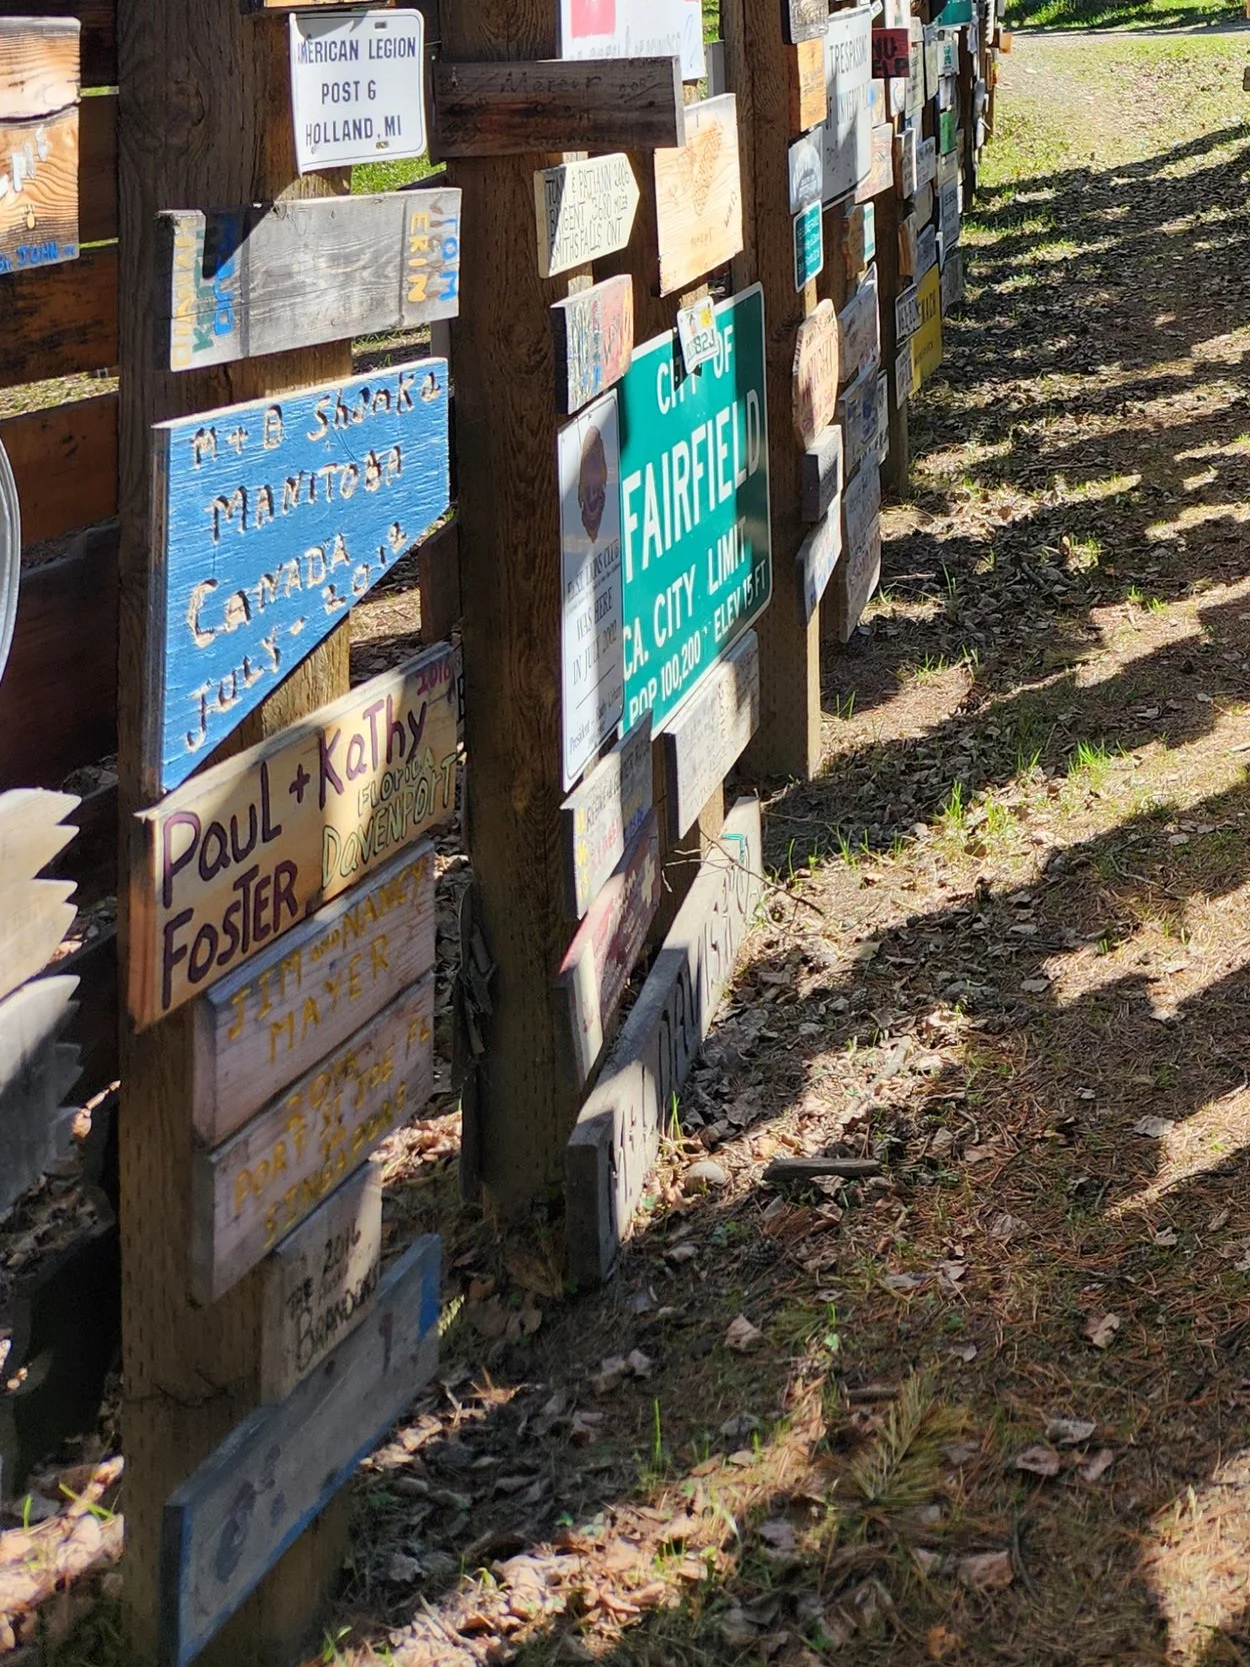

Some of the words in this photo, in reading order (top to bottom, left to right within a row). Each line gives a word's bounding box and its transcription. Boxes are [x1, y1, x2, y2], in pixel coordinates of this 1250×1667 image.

[321, 81, 361, 106] POST
[368, 36, 417, 60] LEGION
[305, 118, 381, 146] HOLLAND,
[384, 114, 402, 137] MI
[204, 445, 403, 544] MANITOBA
[622, 389, 761, 584] FAIRFIELD
[653, 563, 697, 649] CITY
[707, 515, 747, 597] LIMIT
[713, 589, 741, 644] ELEV
[227, 948, 300, 1041] JIM
[342, 860, 425, 954] NANCY
[267, 935, 391, 1065] MAYER
